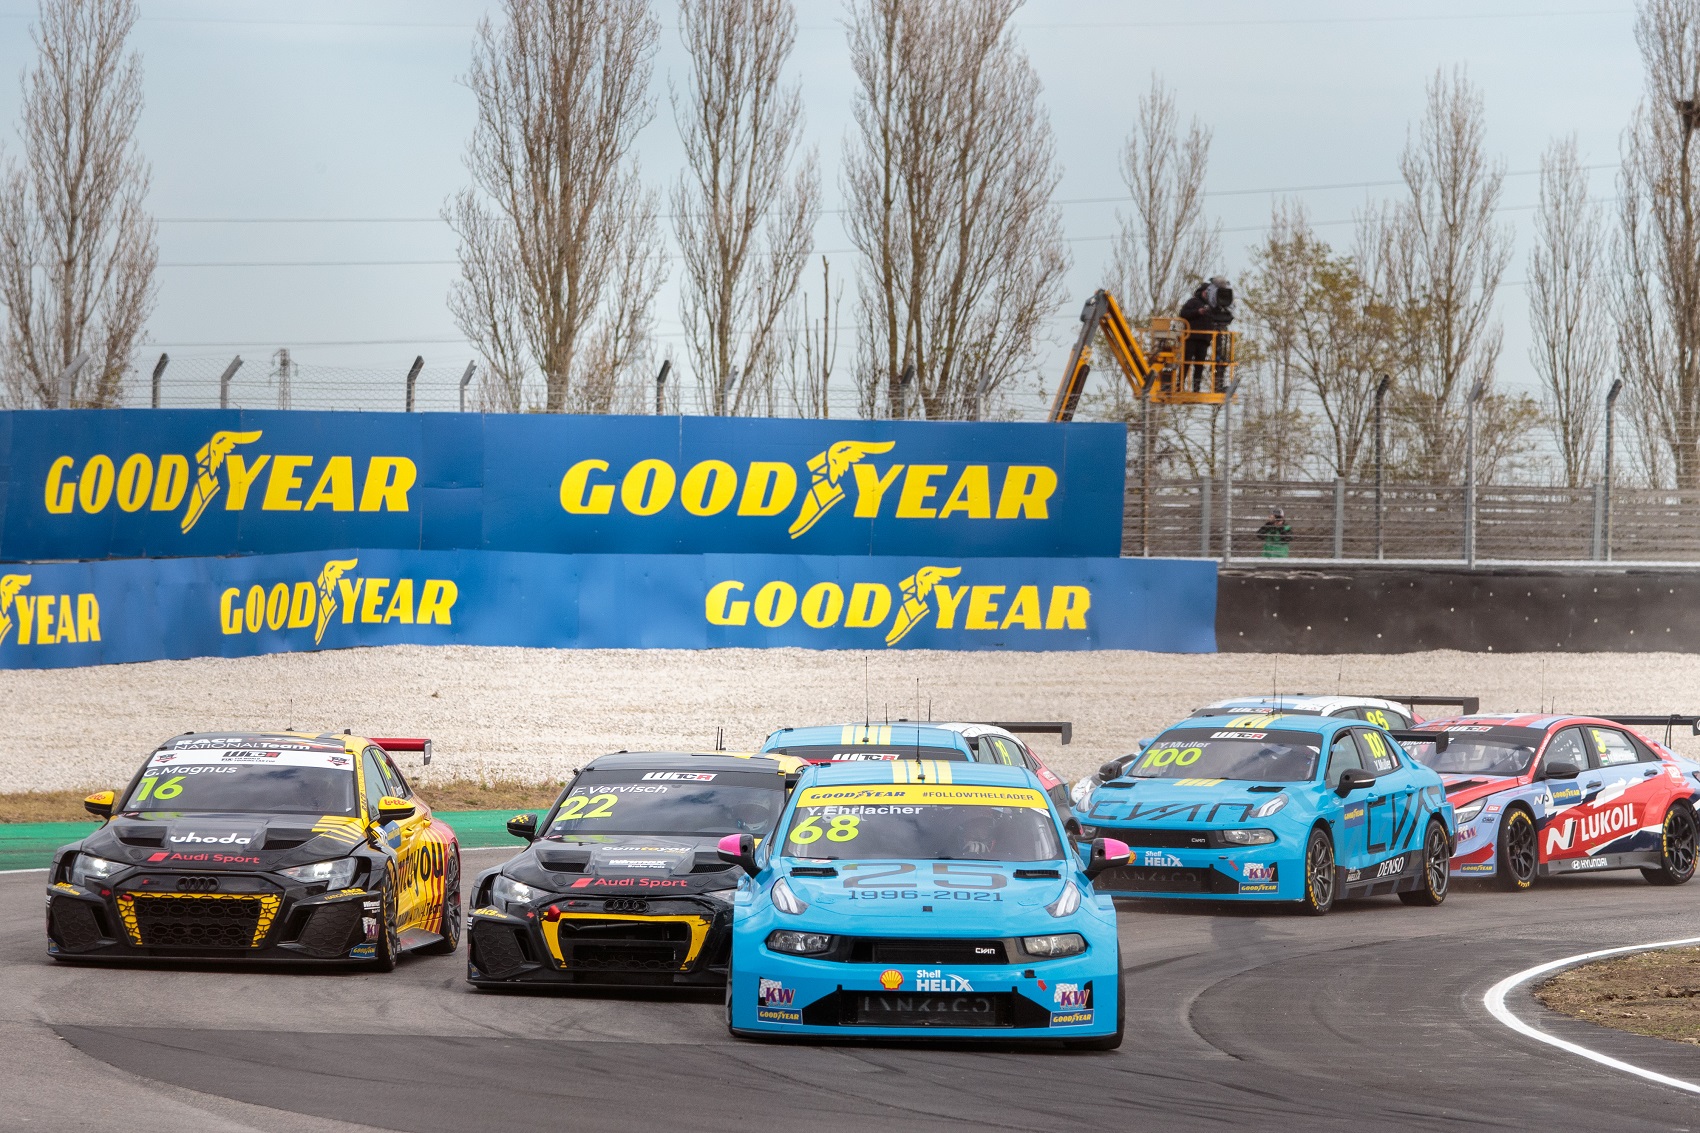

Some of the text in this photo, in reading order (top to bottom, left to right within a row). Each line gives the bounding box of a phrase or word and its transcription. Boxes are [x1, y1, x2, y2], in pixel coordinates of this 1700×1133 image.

[44, 452, 418, 515] GOODYEAR
[559, 457, 1058, 520] GOODYEAR
[219, 577, 459, 636] GOODYEAR
[704, 579, 1092, 632] GOODYEAR
[1591, 729, 1608, 754] 5
[1141, 746, 1203, 770] 100
[143, 765, 238, 779] G.Magnus
[135, 776, 187, 802] 16
[921, 790, 1035, 802] #FOLLOWTHELEADER
[554, 793, 619, 823] 22
[806, 805, 924, 816] Y.Ehrlacher
[789, 813, 861, 845] 68
[1580, 802, 1639, 842] LUKOIL
[169, 831, 252, 846] uhoda
[169, 851, 260, 864] Audi Sport
[1144, 854, 1184, 867] HELIX
[1376, 855, 1406, 879] DENSO
[594, 877, 688, 889] Audi Sport
[842, 863, 1009, 891] 25
[848, 888, 1004, 903] 1996-2021
[916, 969, 941, 979] Shell
[916, 976, 974, 992] HELIX
[764, 986, 797, 1004] KW
[1060, 989, 1091, 1006] KW
